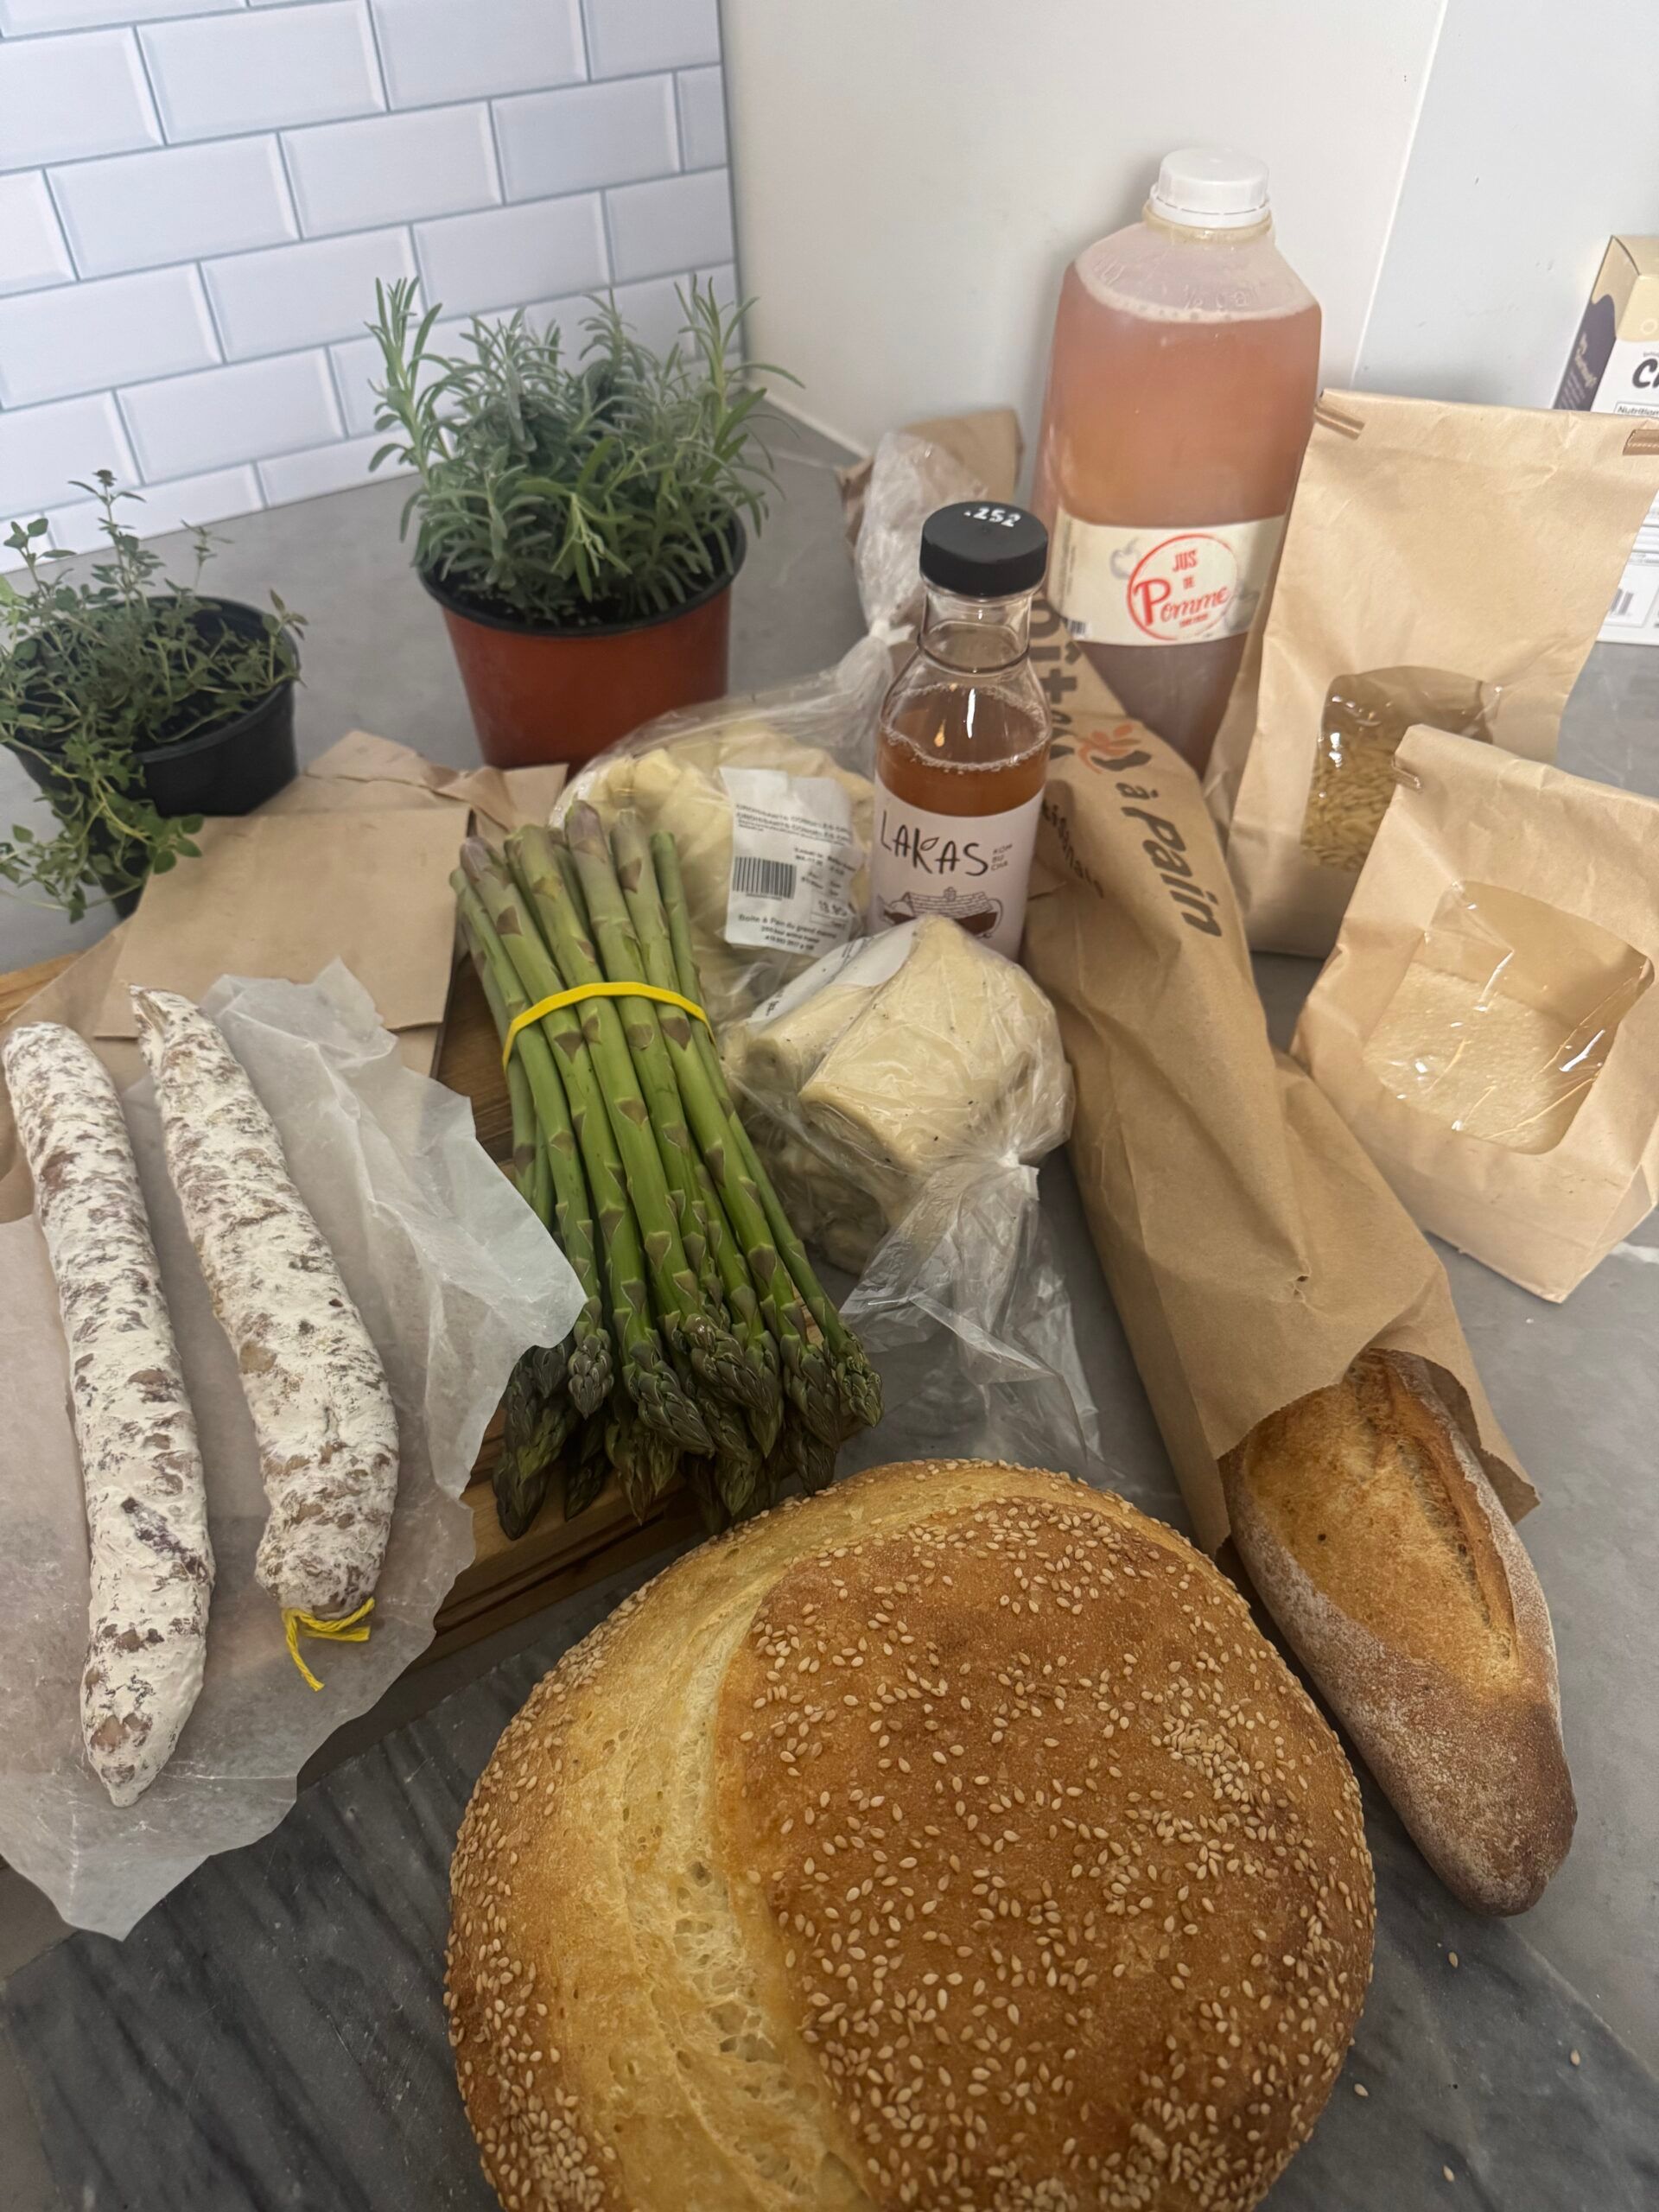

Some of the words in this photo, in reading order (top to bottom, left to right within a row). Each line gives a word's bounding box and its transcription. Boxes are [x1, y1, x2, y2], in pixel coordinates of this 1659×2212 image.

[1172, 550, 1198, 572] JUS
[1133, 578, 1229, 626] Pomme
[880, 810, 989, 877] LAKAS
[1121, 805, 1223, 938] Pain
